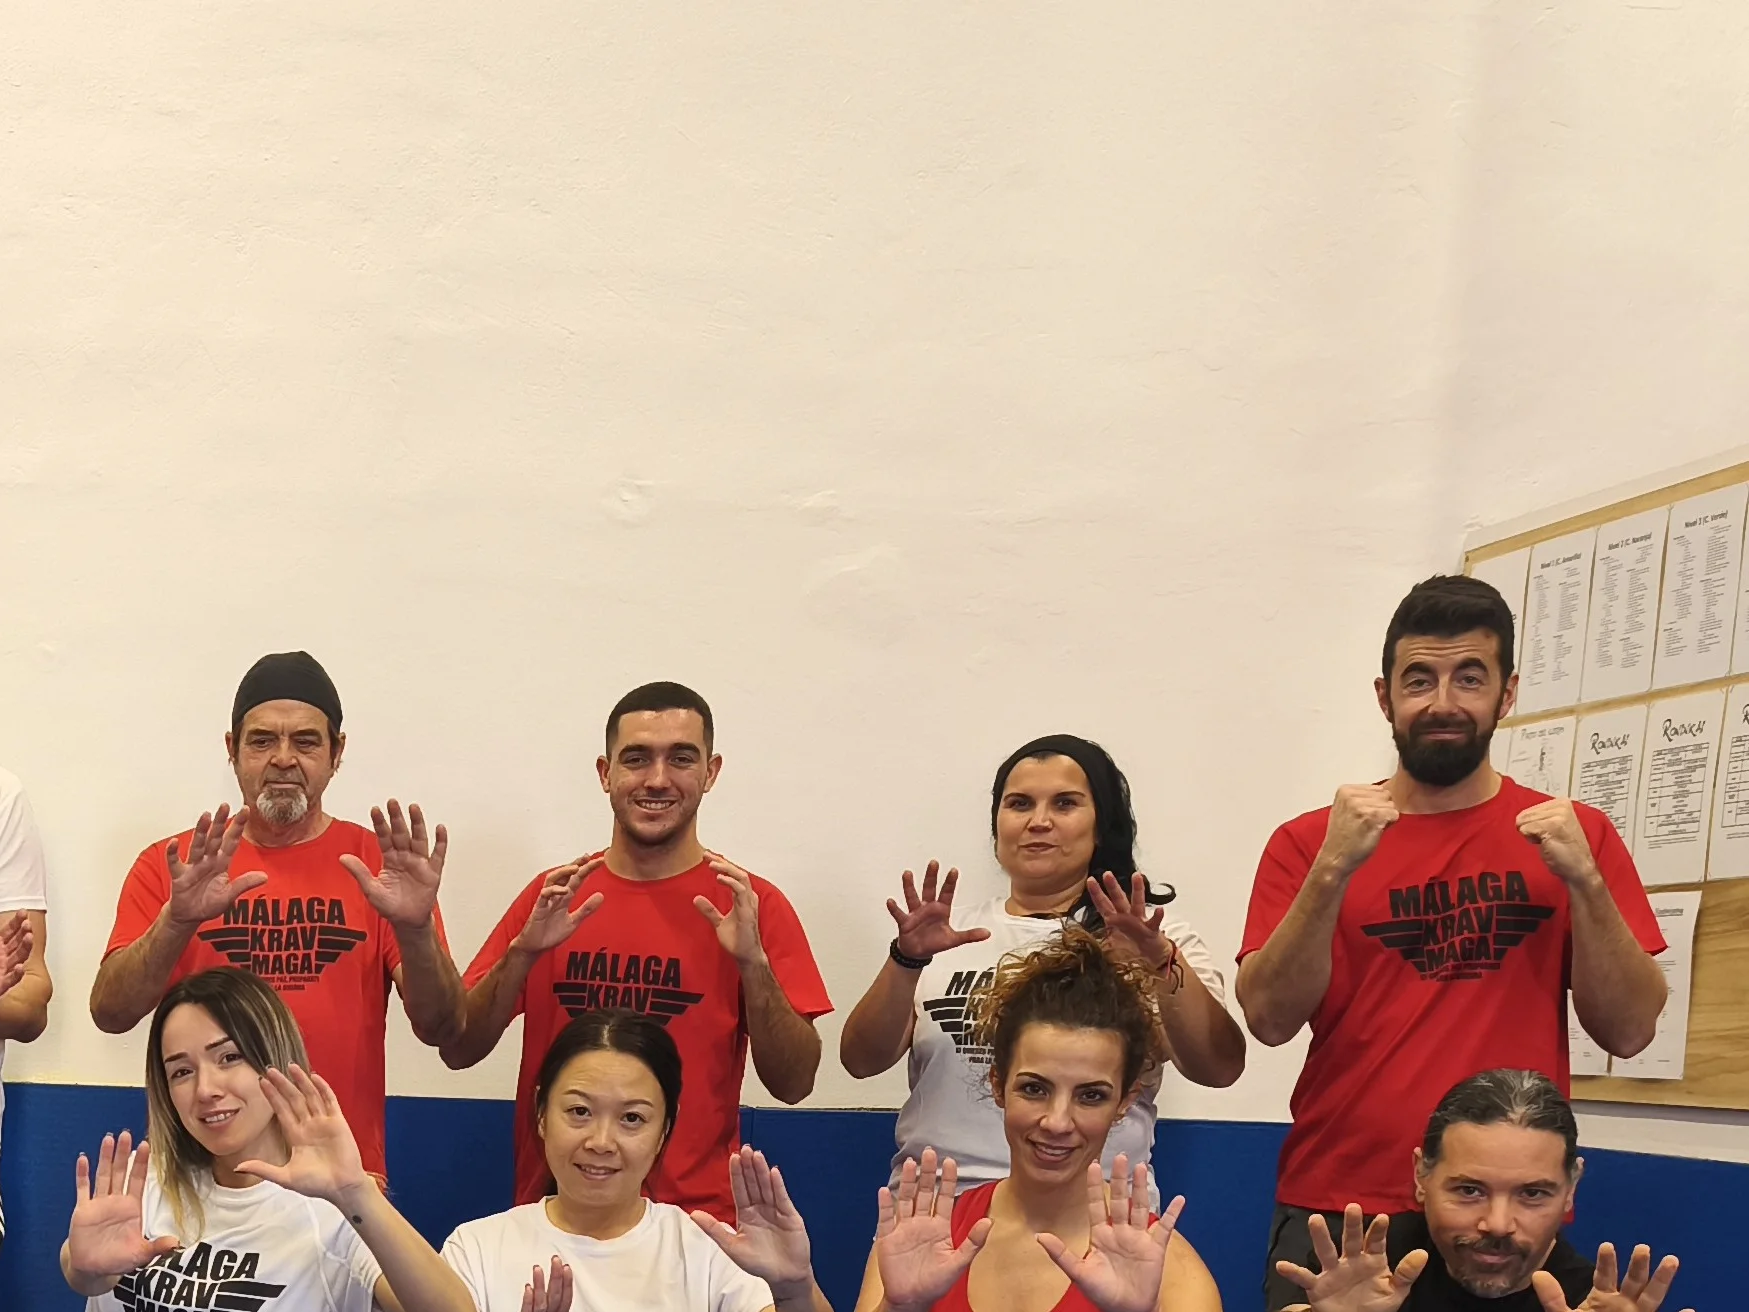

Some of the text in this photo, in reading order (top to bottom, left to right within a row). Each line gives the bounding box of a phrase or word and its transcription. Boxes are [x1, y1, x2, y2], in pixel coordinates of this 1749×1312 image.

[223, 894, 346, 926] MÁLAGA
[1389, 871, 1530, 918] MÁLAGA
[251, 926, 318, 952] KRAV
[1423, 905, 1494, 946] KRAV
[252, 953, 313, 975] MAGA
[566, 947, 681, 988] MÁLAGA
[1425, 936, 1491, 971] MAGA
[587, 984, 652, 1013] KRAV
[134, 1268, 222, 1309] KRAV
